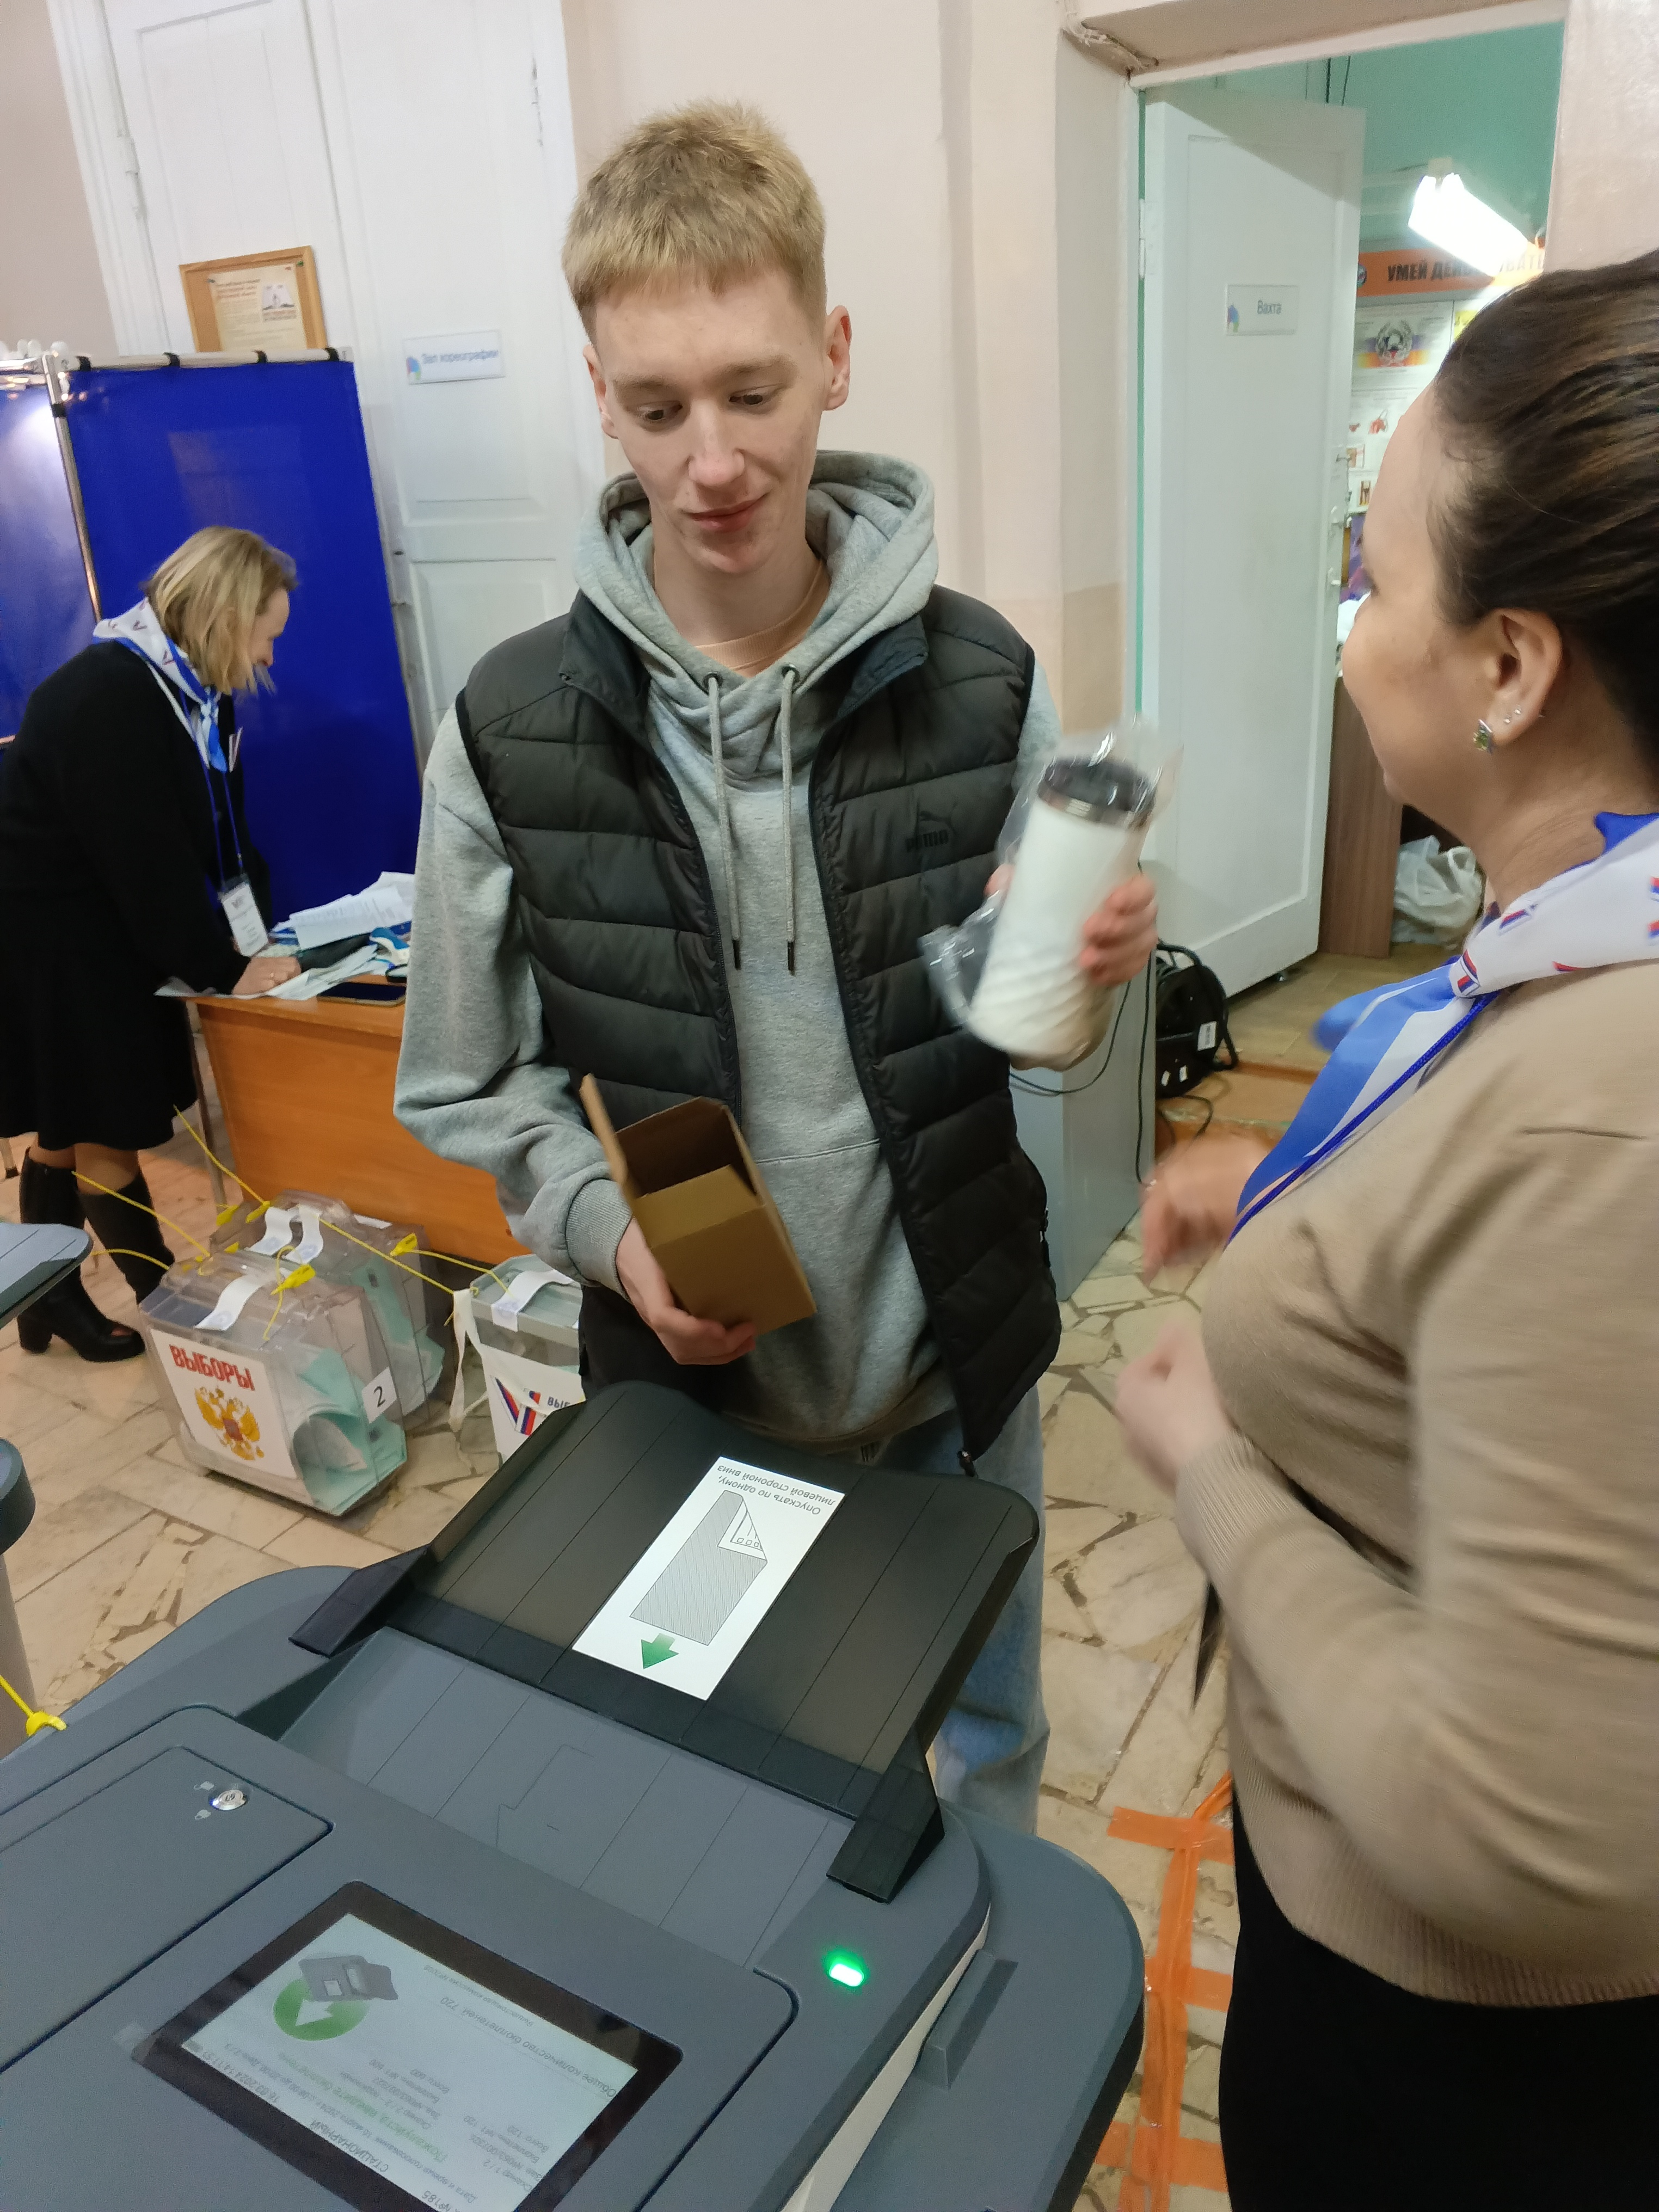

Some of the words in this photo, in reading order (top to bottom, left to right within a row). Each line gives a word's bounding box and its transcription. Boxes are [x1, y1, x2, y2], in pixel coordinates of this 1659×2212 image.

[1388, 259, 1427, 281] УМЕЙ
[1257, 300, 1281, 315] Вахта
[169, 1344, 255, 1391] ВЫБОРЫ
[373, 1386, 385, 1408] 2
[717, 1465, 741, 1477] вниз
[718, 1476, 755, 1493] одному,
[742, 1473, 789, 1491] стороной
[758, 1490, 771, 1498] по
[790, 1488, 836, 1506] лицевой
[774, 1494, 821, 1515] Опускать
[439, 1997, 459, 2010] 720
[522, 2042, 580, 2075] количество
